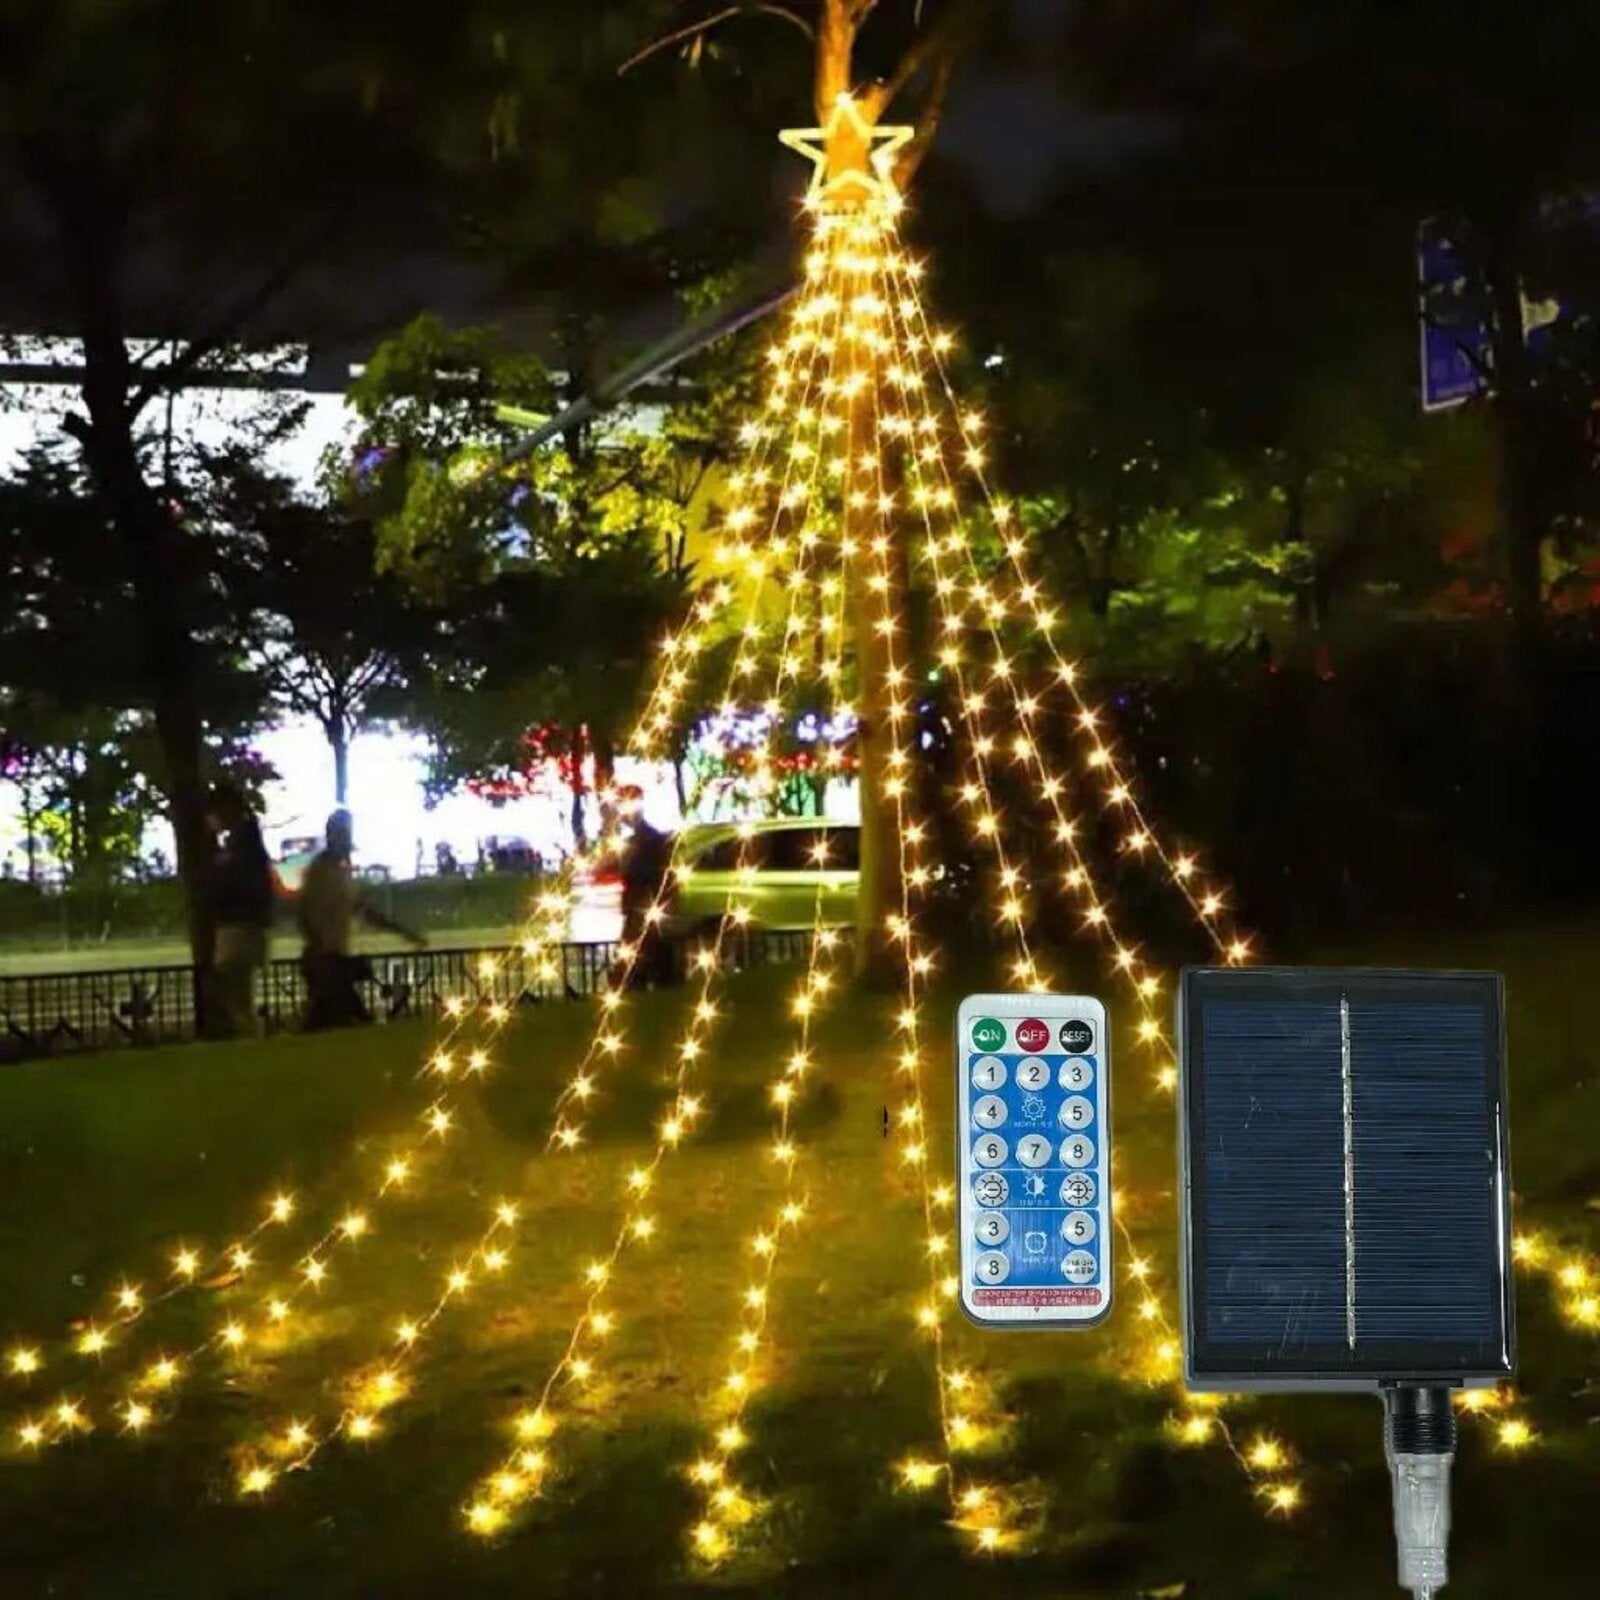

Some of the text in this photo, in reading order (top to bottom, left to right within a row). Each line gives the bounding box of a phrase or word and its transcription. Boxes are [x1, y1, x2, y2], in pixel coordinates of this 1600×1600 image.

[1019, 1030, 1047, 1041] OFF
[987, 1066, 995, 1082] 1
[1029, 1067, 1039, 1082] 2
[1072, 1067, 1082, 1082] 3
[987, 1105, 997, 1119] 4
[1072, 1106, 1083, 1120] 5
[987, 1143, 998, 1158] 6
[1031, 1143, 1041, 1158] 7
[1073, 1144, 1083, 1158] 8
[988, 1221, 999, 1237] 3
[1075, 1221, 1085, 1236] 5
[989, 1260, 999, 1275] 8
